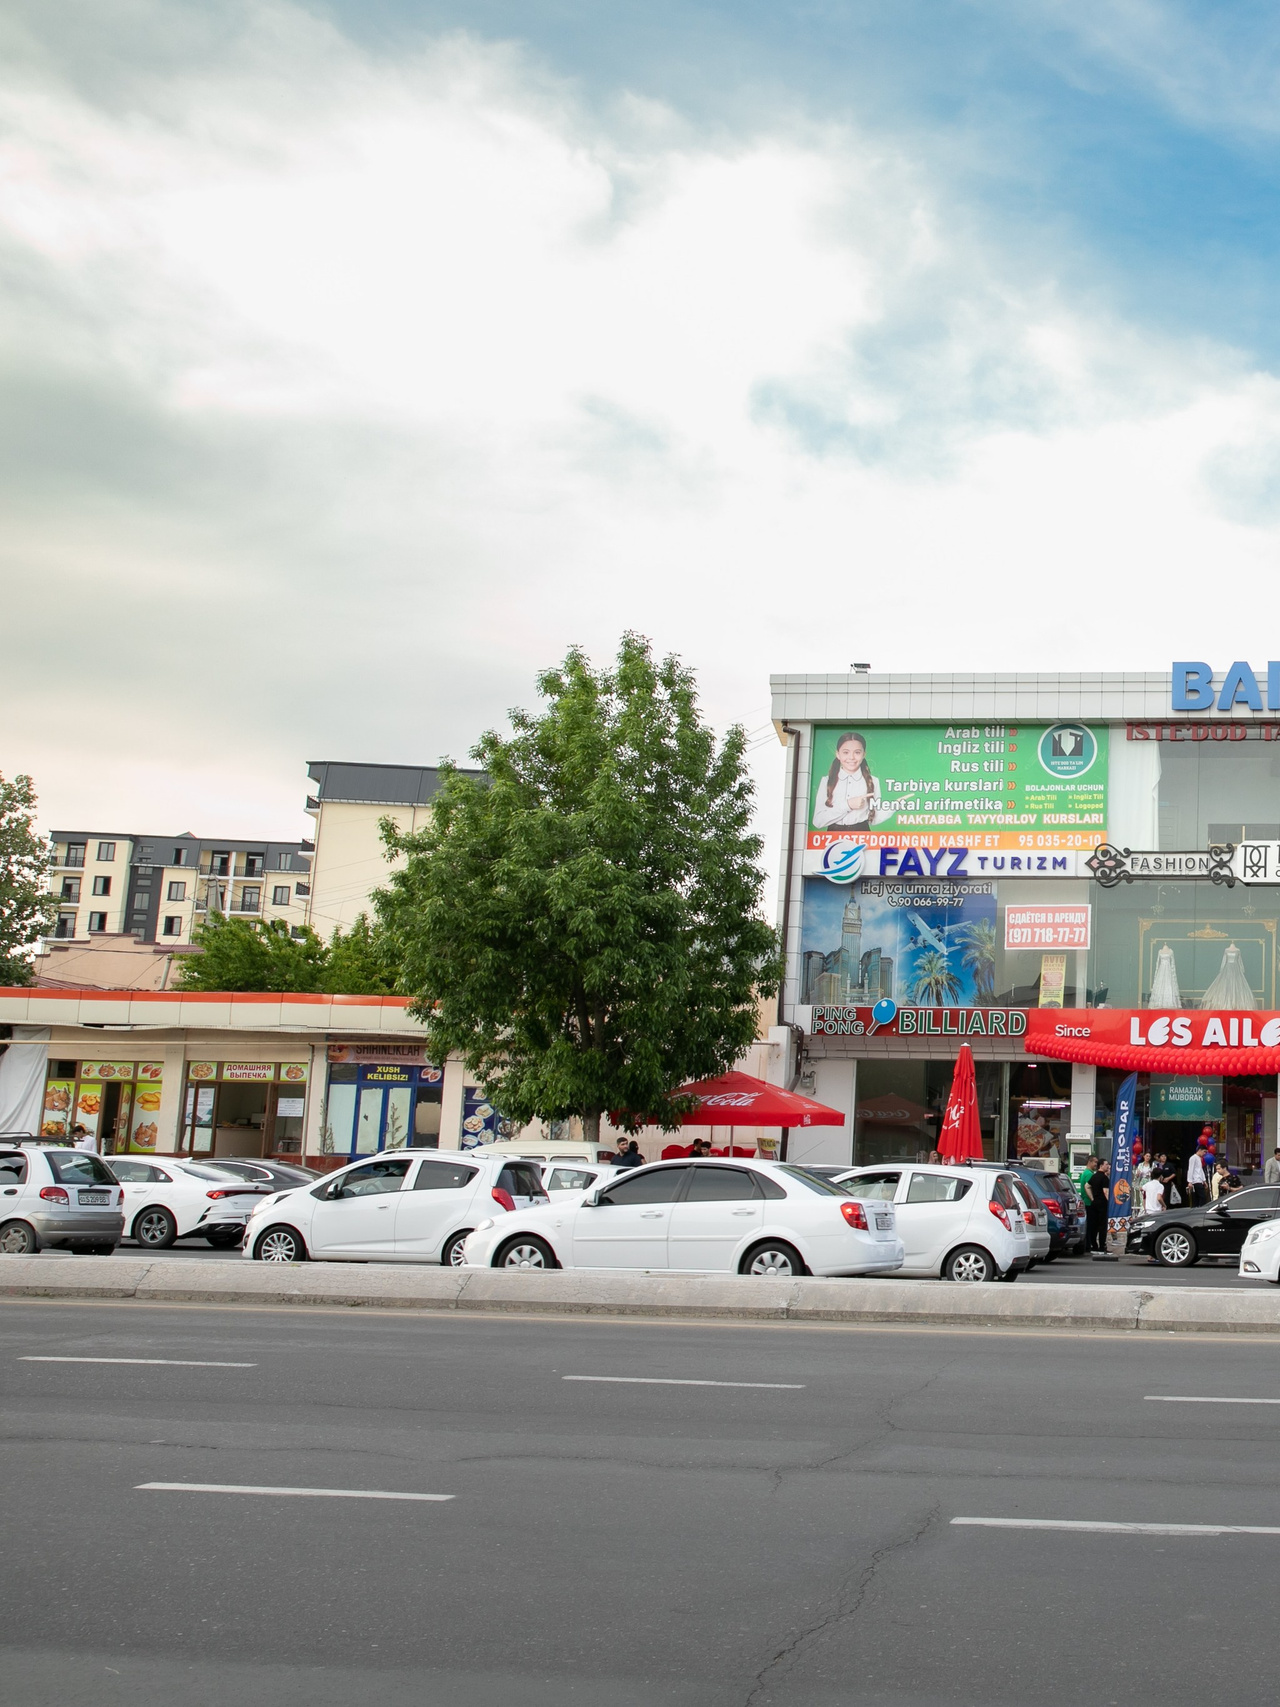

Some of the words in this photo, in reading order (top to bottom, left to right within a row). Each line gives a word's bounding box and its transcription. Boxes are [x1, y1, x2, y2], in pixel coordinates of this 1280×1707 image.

[944, 727, 980, 739] Arab
[984, 726, 1005, 738] tili
[938, 741, 980, 756] Ingliz
[984, 741, 1005, 753] tili
[950, 760, 979, 773] Rus
[983, 760, 1004, 772] tili
[886, 779, 940, 794] Tarbiya
[944, 779, 1004, 792] kurslari
[869, 798, 920, 811] Mental
[924, 798, 1002, 811] arifmetika
[897, 814, 961, 825] MAKTABGA
[967, 814, 1037, 825] TAYYORLOV
[1043, 813, 1103, 825] KURSLARI
[812, 834, 833, 847] O'Z
[939, 834, 981, 846] KASHF
[985, 834, 1000, 846] ET
[1018, 834, 1035, 846] 95
[1037, 834, 1101, 846] 035-20-10
[879, 847, 968, 876] FAYZ
[977, 856, 1067, 871] TURIZM
[1130, 857, 1210, 871] FASHION
[861, 882, 884, 896] Haj
[886, 884, 905, 895] va
[907, 884, 939, 895] umra
[942, 882, 992, 896] ziyorati
[899, 897, 911, 907] 90
[913, 897, 965, 907] 066-99-77
[1009, 912, 1046, 924] СДАЁТСЯ
[1047, 913, 1053, 923] В
[1054, 912, 1086, 924] АРЕНДУ
[1008, 928, 1031, 943] (97)
[1034, 928, 1086, 943] 718-77-77
[812, 1006, 857, 1020] PING
[812, 1020, 864, 1035] PONG
[899, 1010, 1026, 1035] BILLIARD
[1055, 1024, 1091, 1037] Since
[1130, 1017, 1192, 1046] LES
[226, 1064, 271, 1072] ДОМАШНЯЯ
